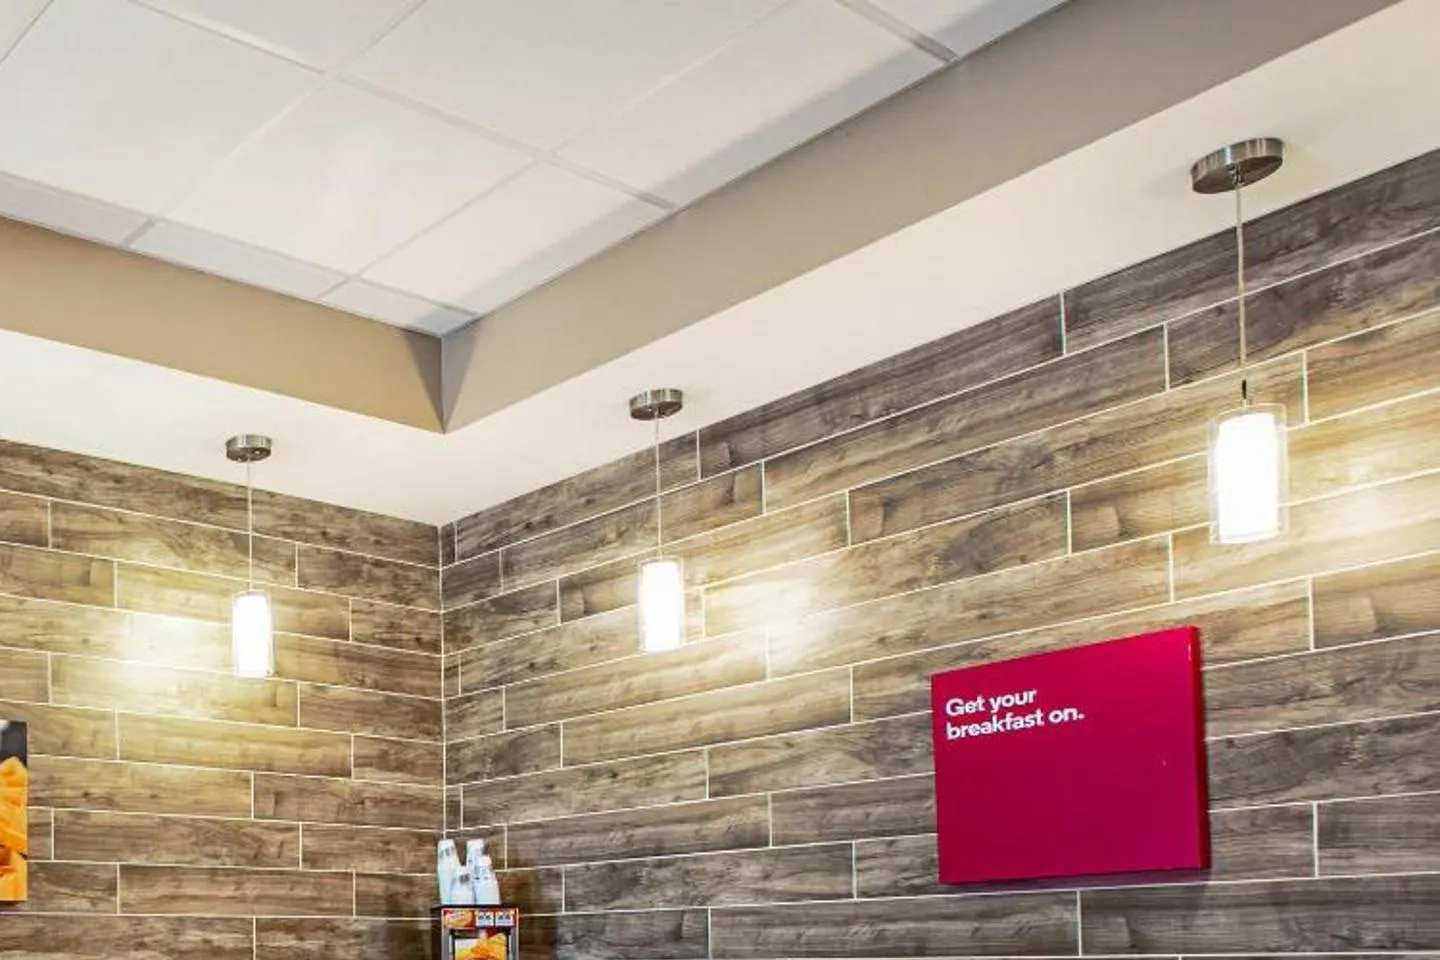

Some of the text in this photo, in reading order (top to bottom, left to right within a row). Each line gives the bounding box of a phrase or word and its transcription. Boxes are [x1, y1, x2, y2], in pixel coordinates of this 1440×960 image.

[945, 688, 1037, 717] Get your
[945, 707, 1085, 740] breakfast on.
